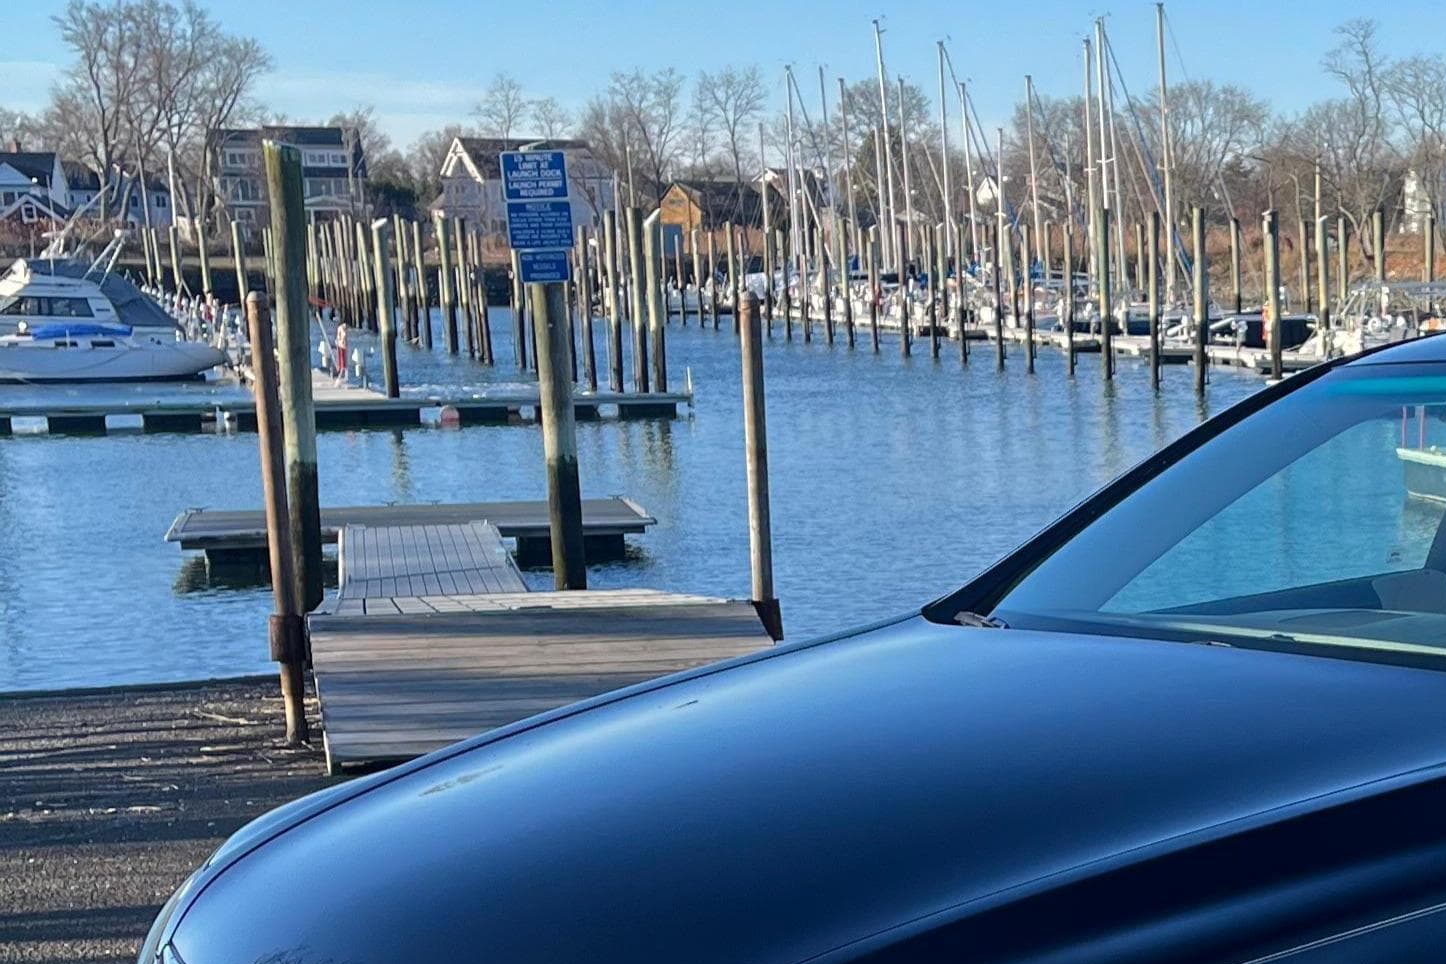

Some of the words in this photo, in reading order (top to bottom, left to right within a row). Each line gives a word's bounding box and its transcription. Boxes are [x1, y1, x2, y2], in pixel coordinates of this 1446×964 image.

[525, 153, 553, 162] MINUTE
[518, 161, 537, 170] LIMIT
[540, 161, 549, 169] AT
[507, 170, 539, 178] LAUNCH
[540, 168, 562, 177] DOCK
[508, 181, 537, 190] LAUNCH
[538, 180, 562, 188] PERMIT
[519, 188, 554, 198] REQUIRED
